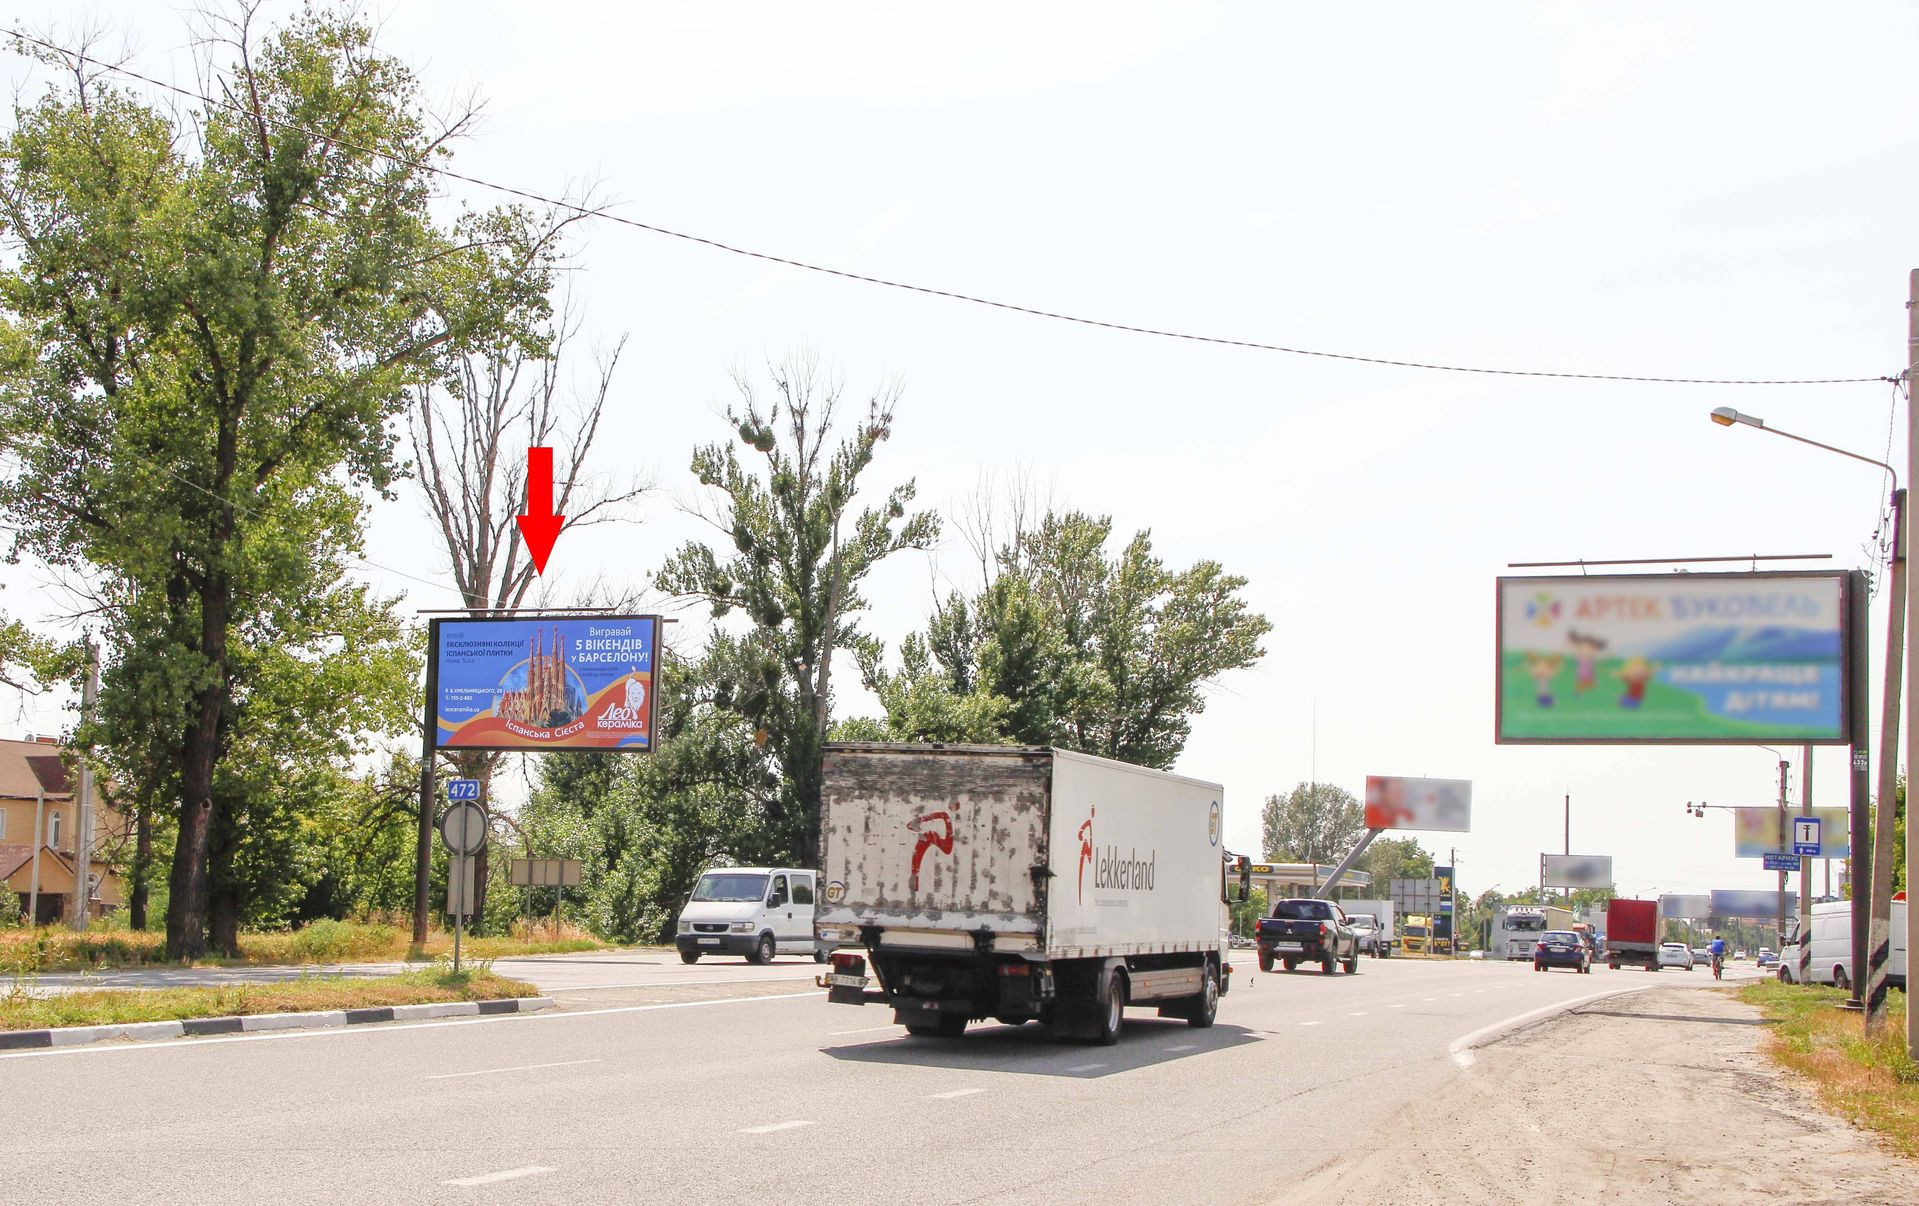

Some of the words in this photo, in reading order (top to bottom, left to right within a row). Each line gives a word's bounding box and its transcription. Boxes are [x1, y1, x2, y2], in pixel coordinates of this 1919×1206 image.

[1574, 596, 1662, 620] АРТЕК
[590, 626, 632, 638] Вигравай
[493, 640, 524, 648] КОЛЕКЦІЇ
[575, 640, 582, 651] 5
[585, 639, 642, 652] ВІКЕНДІВ
[446, 649, 486, 657] ІСПАНСЬКОЇ
[578, 652, 649, 663] БАРСЕЛОНУ!
[597, 702, 634, 720] Лео
[505, 719, 550, 739] Іспанська
[554, 721, 585, 738] Сієста
[597, 719, 642, 730] кераміка
[450, 783, 475, 797] 472
[1765, 854, 1799, 862] НОТАРИУС
[1094, 844, 1156, 891] Lekkerland
[827, 886, 843, 899] GT
